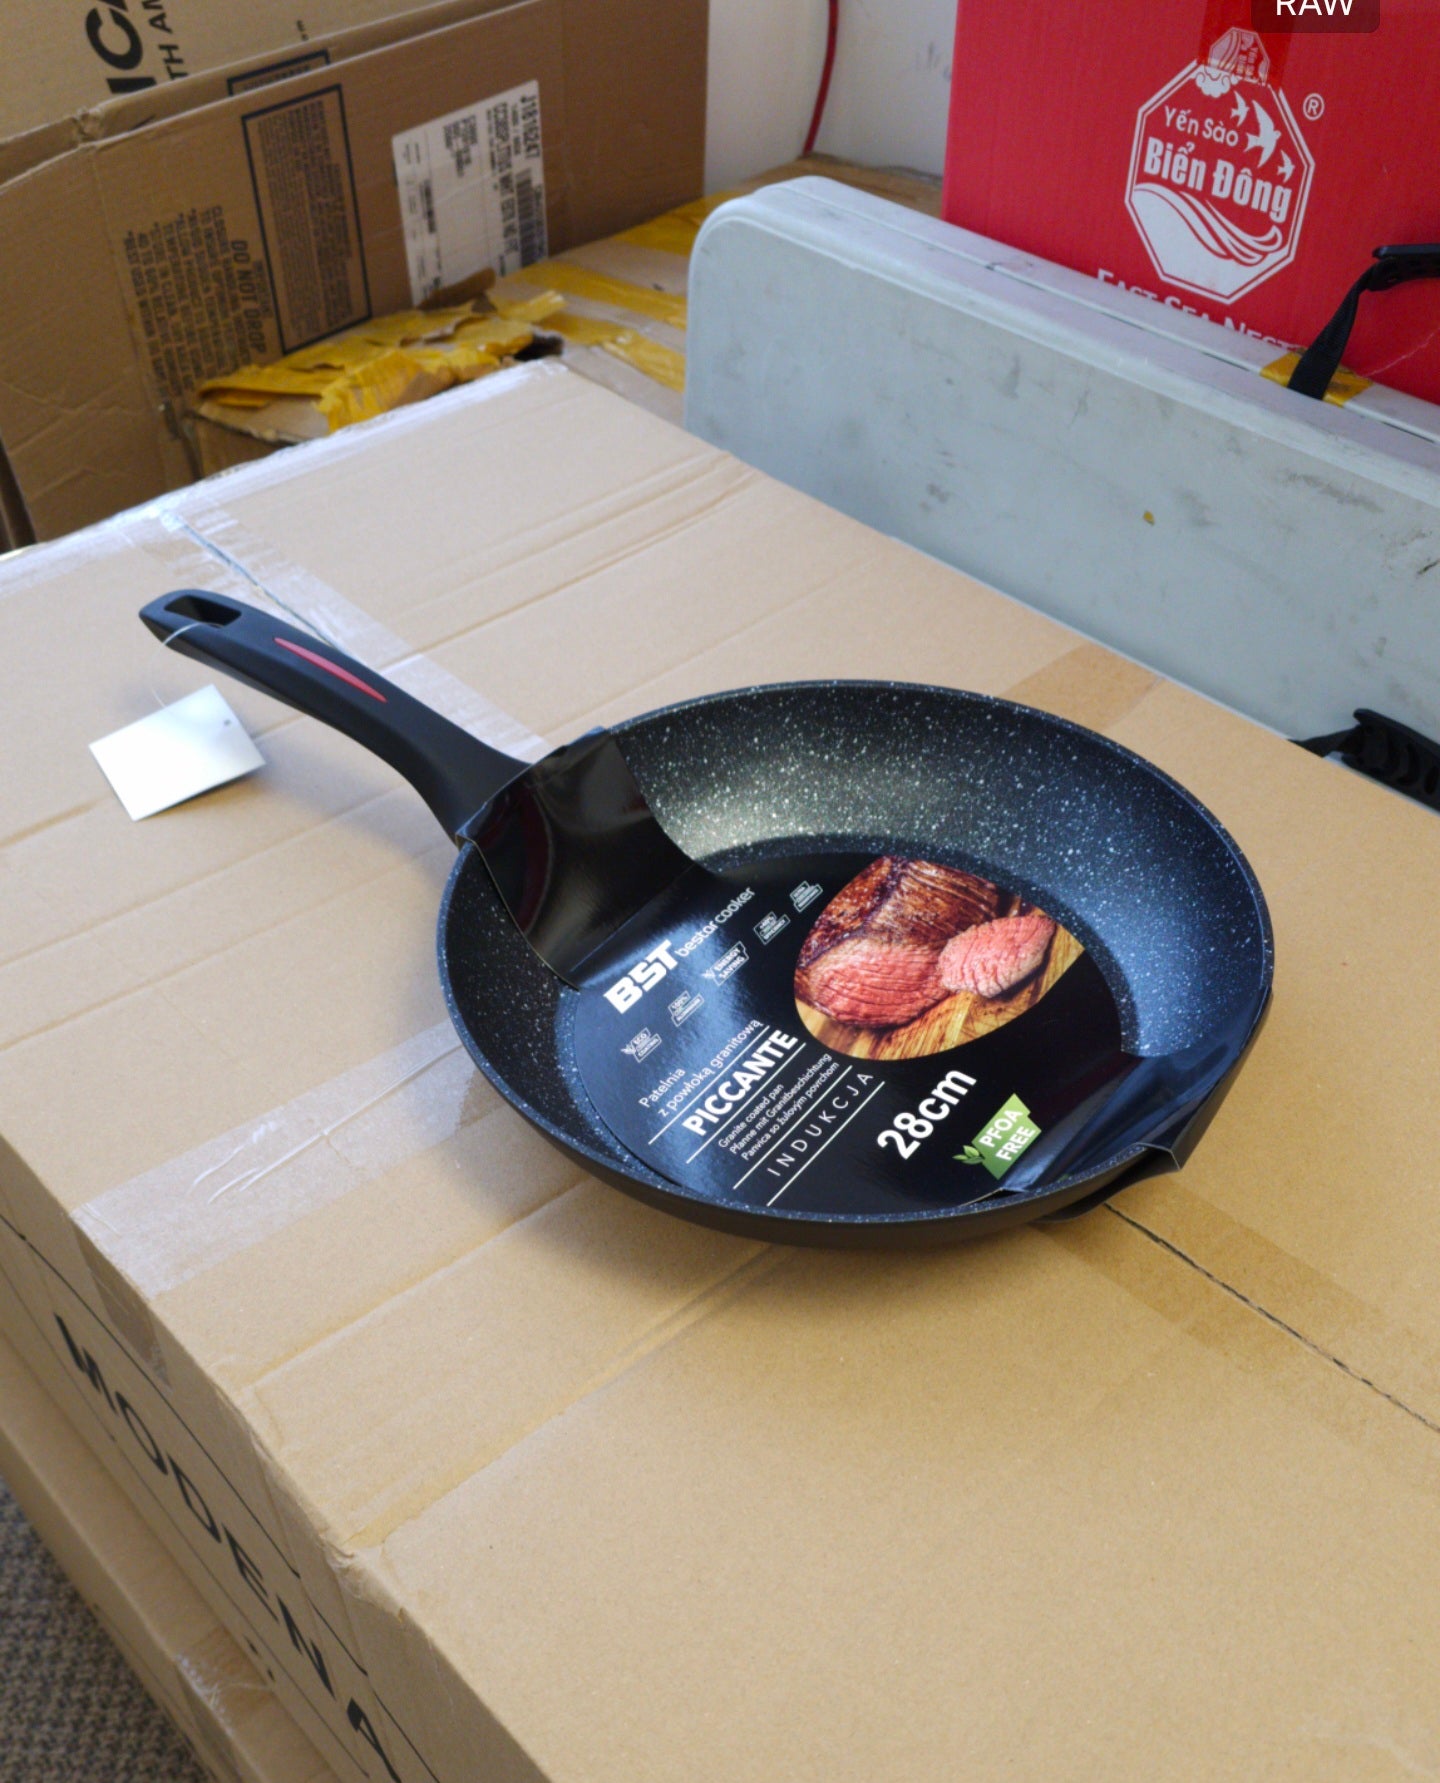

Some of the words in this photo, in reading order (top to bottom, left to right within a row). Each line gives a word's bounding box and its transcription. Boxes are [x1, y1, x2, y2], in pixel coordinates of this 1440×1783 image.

[1164, 104, 1200, 137] Yến
[1202, 119, 1239, 147] Sào
[1143, 136, 1207, 192] Biển
[1211, 158, 1293, 223] Đông
[604, 939, 678, 1014] BST
[674, 921, 717, 957] bestar
[715, 888, 754, 923] cooker
[713, 947, 741, 972] ENERGY
[717, 956, 745, 979] SAVING
[639, 1069, 685, 1107] Patelnia
[657, 1107, 669, 1117] z
[665, 1066, 716, 1112] powłoką
[709, 1018, 764, 1070] granitową
[681, 1030, 797, 1135] PICCANTE
[730, 1130, 756, 1154] Pfanne
[756, 1117, 769, 1130] mit
[766, 1054, 832, 1117] Granitbeschichtung
[719, 1122, 746, 1147] Granite
[746, 1097, 770, 1122] coated
[769, 1085, 783, 1100] pan
[741, 1134, 771, 1160] Panvica
[770, 1125, 779, 1133] so
[805, 1063, 839, 1098] povrchom
[767, 1072, 874, 1177] INDUKCJA
[877, 1071, 976, 1159] 28cm
[980, 1110, 1023, 1147] PFOA
[997, 1126, 1035, 1160] FREE
